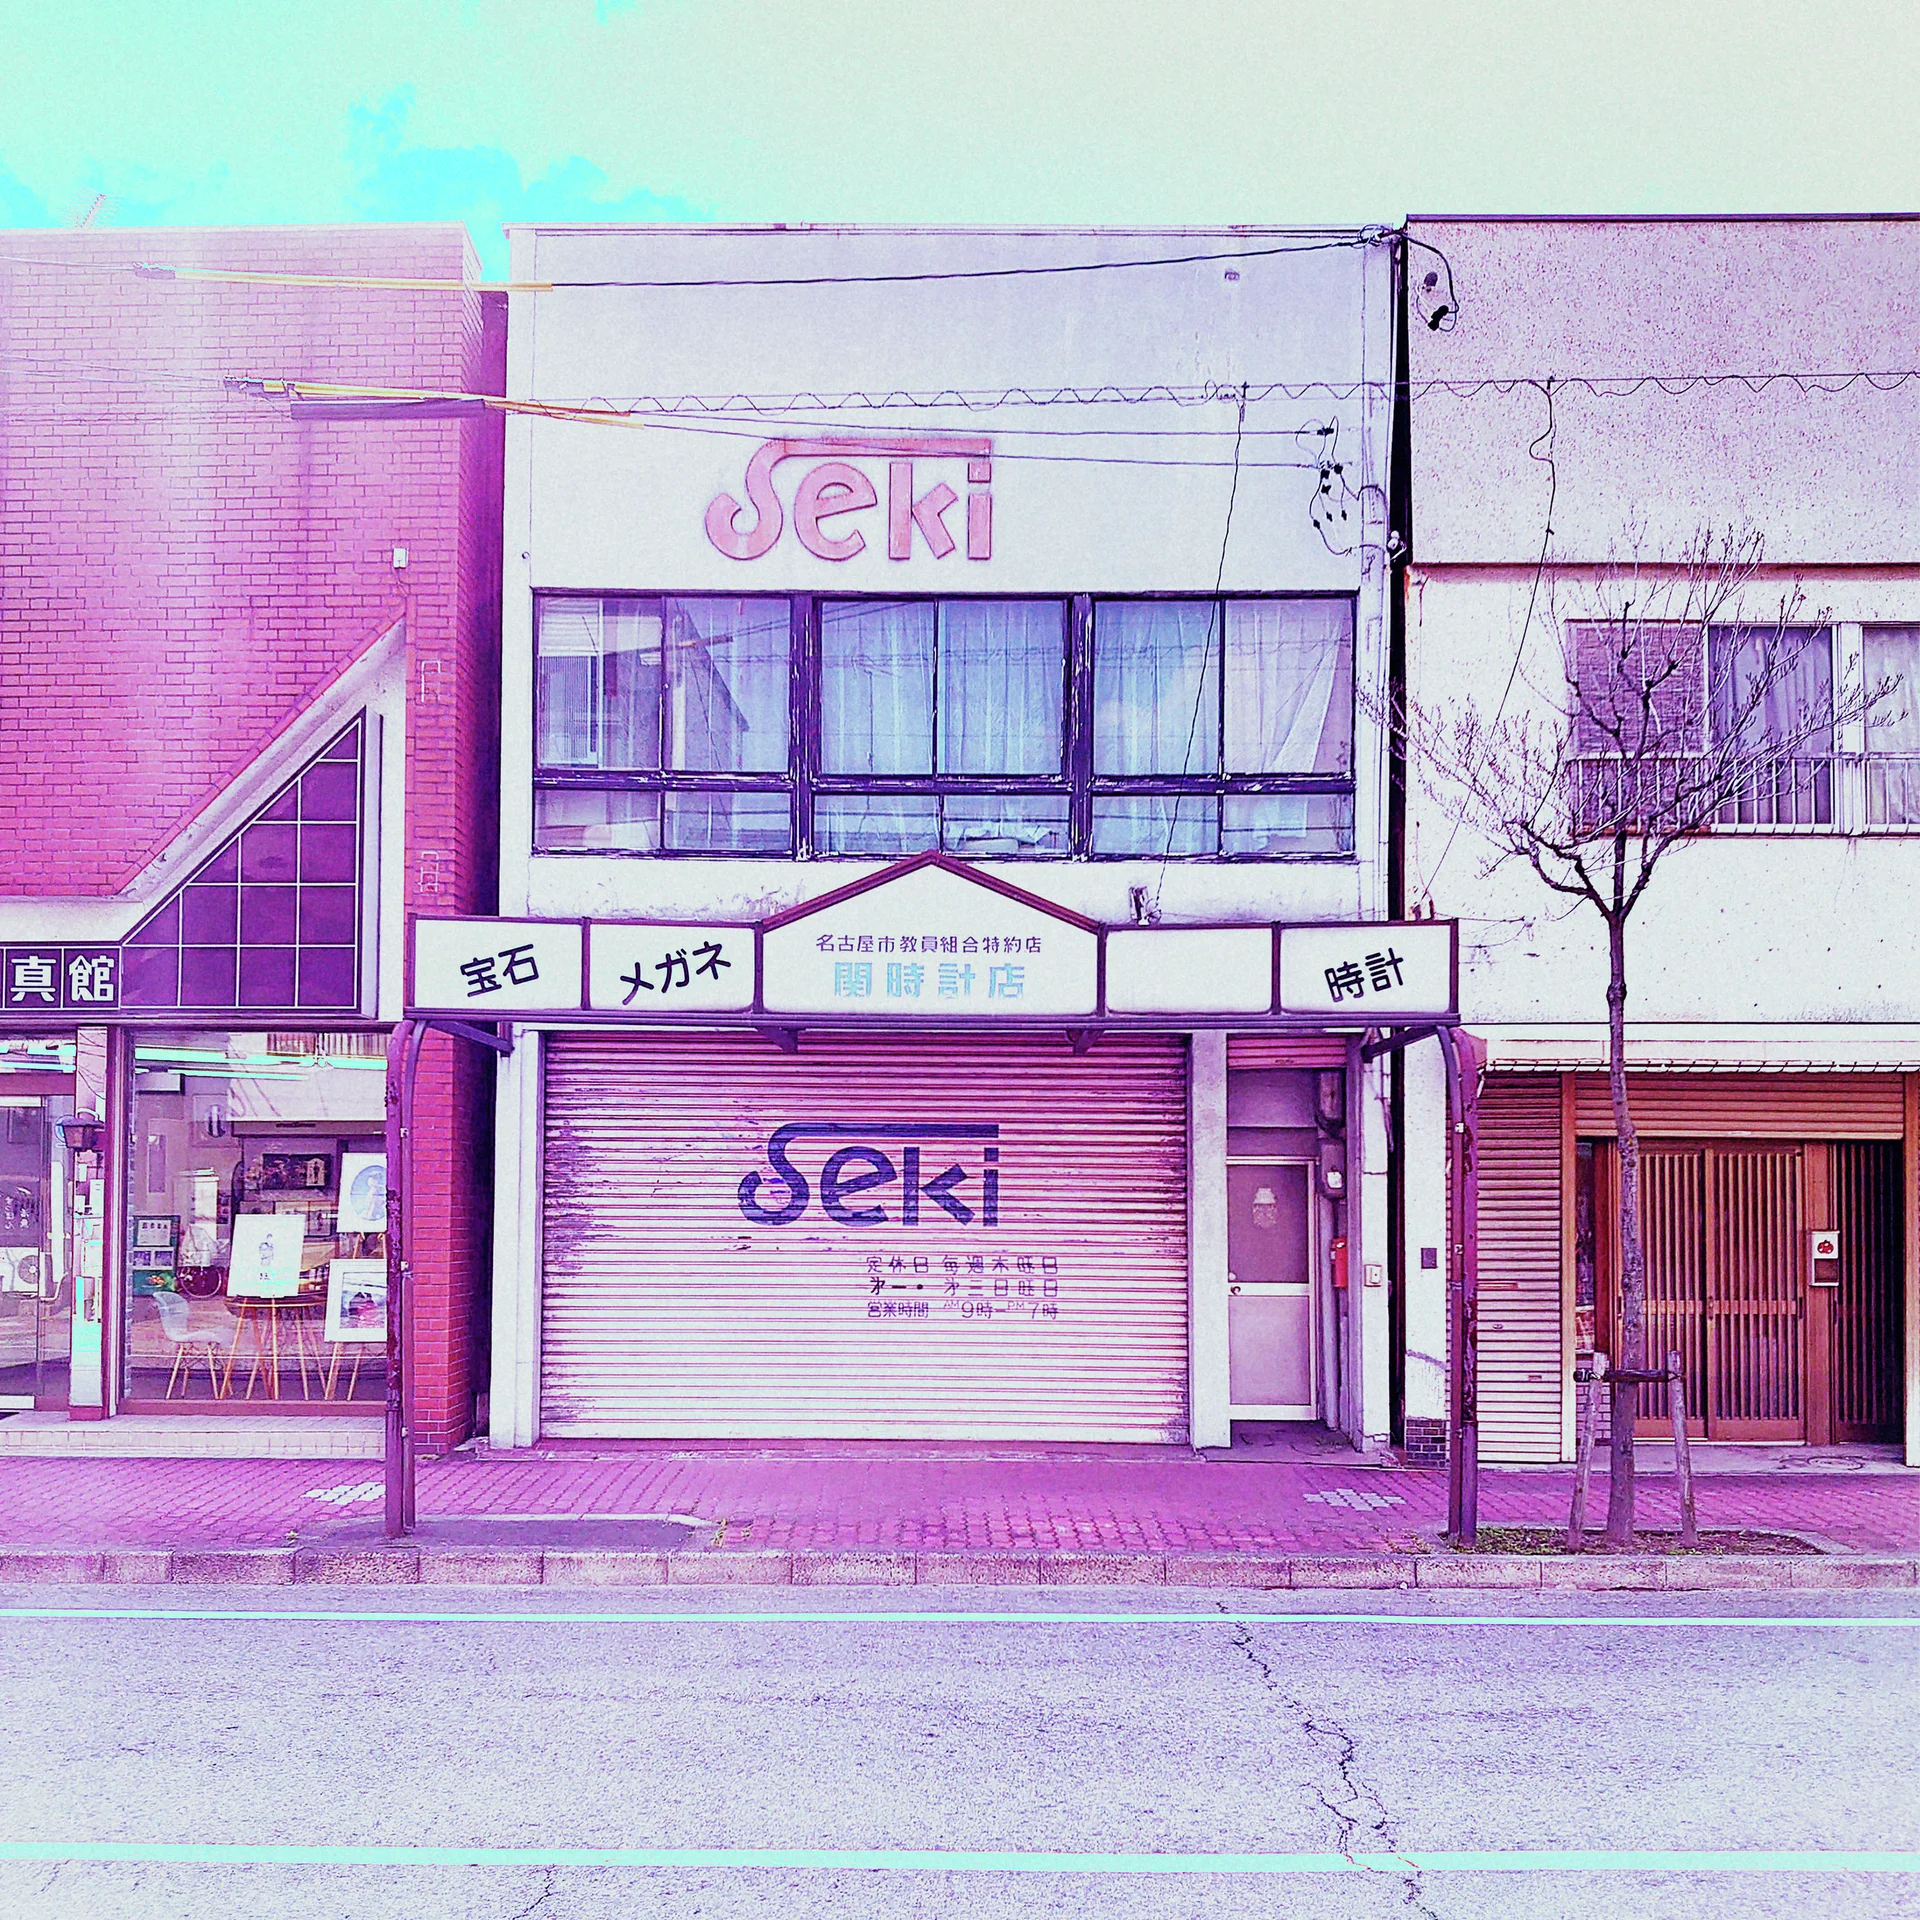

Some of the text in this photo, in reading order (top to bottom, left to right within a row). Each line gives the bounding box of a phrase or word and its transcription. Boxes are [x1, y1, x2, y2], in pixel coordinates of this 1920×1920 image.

[705, 437, 993, 561] Seki
[815, 934, 1042, 954] 名古屋市教員組合特約店
[10, 955, 115, 1002] 真館
[460, 943, 540, 997] 宝石
[620, 941, 732, 1006] メガネ
[834, 962, 1025, 999] 関時計店
[1324, 947, 1404, 1003] 時計
[737, 1122, 999, 1228] Seki
[866, 1256, 929, 1273] 定休日
[868, 1301, 929, 1318] 営業時間
